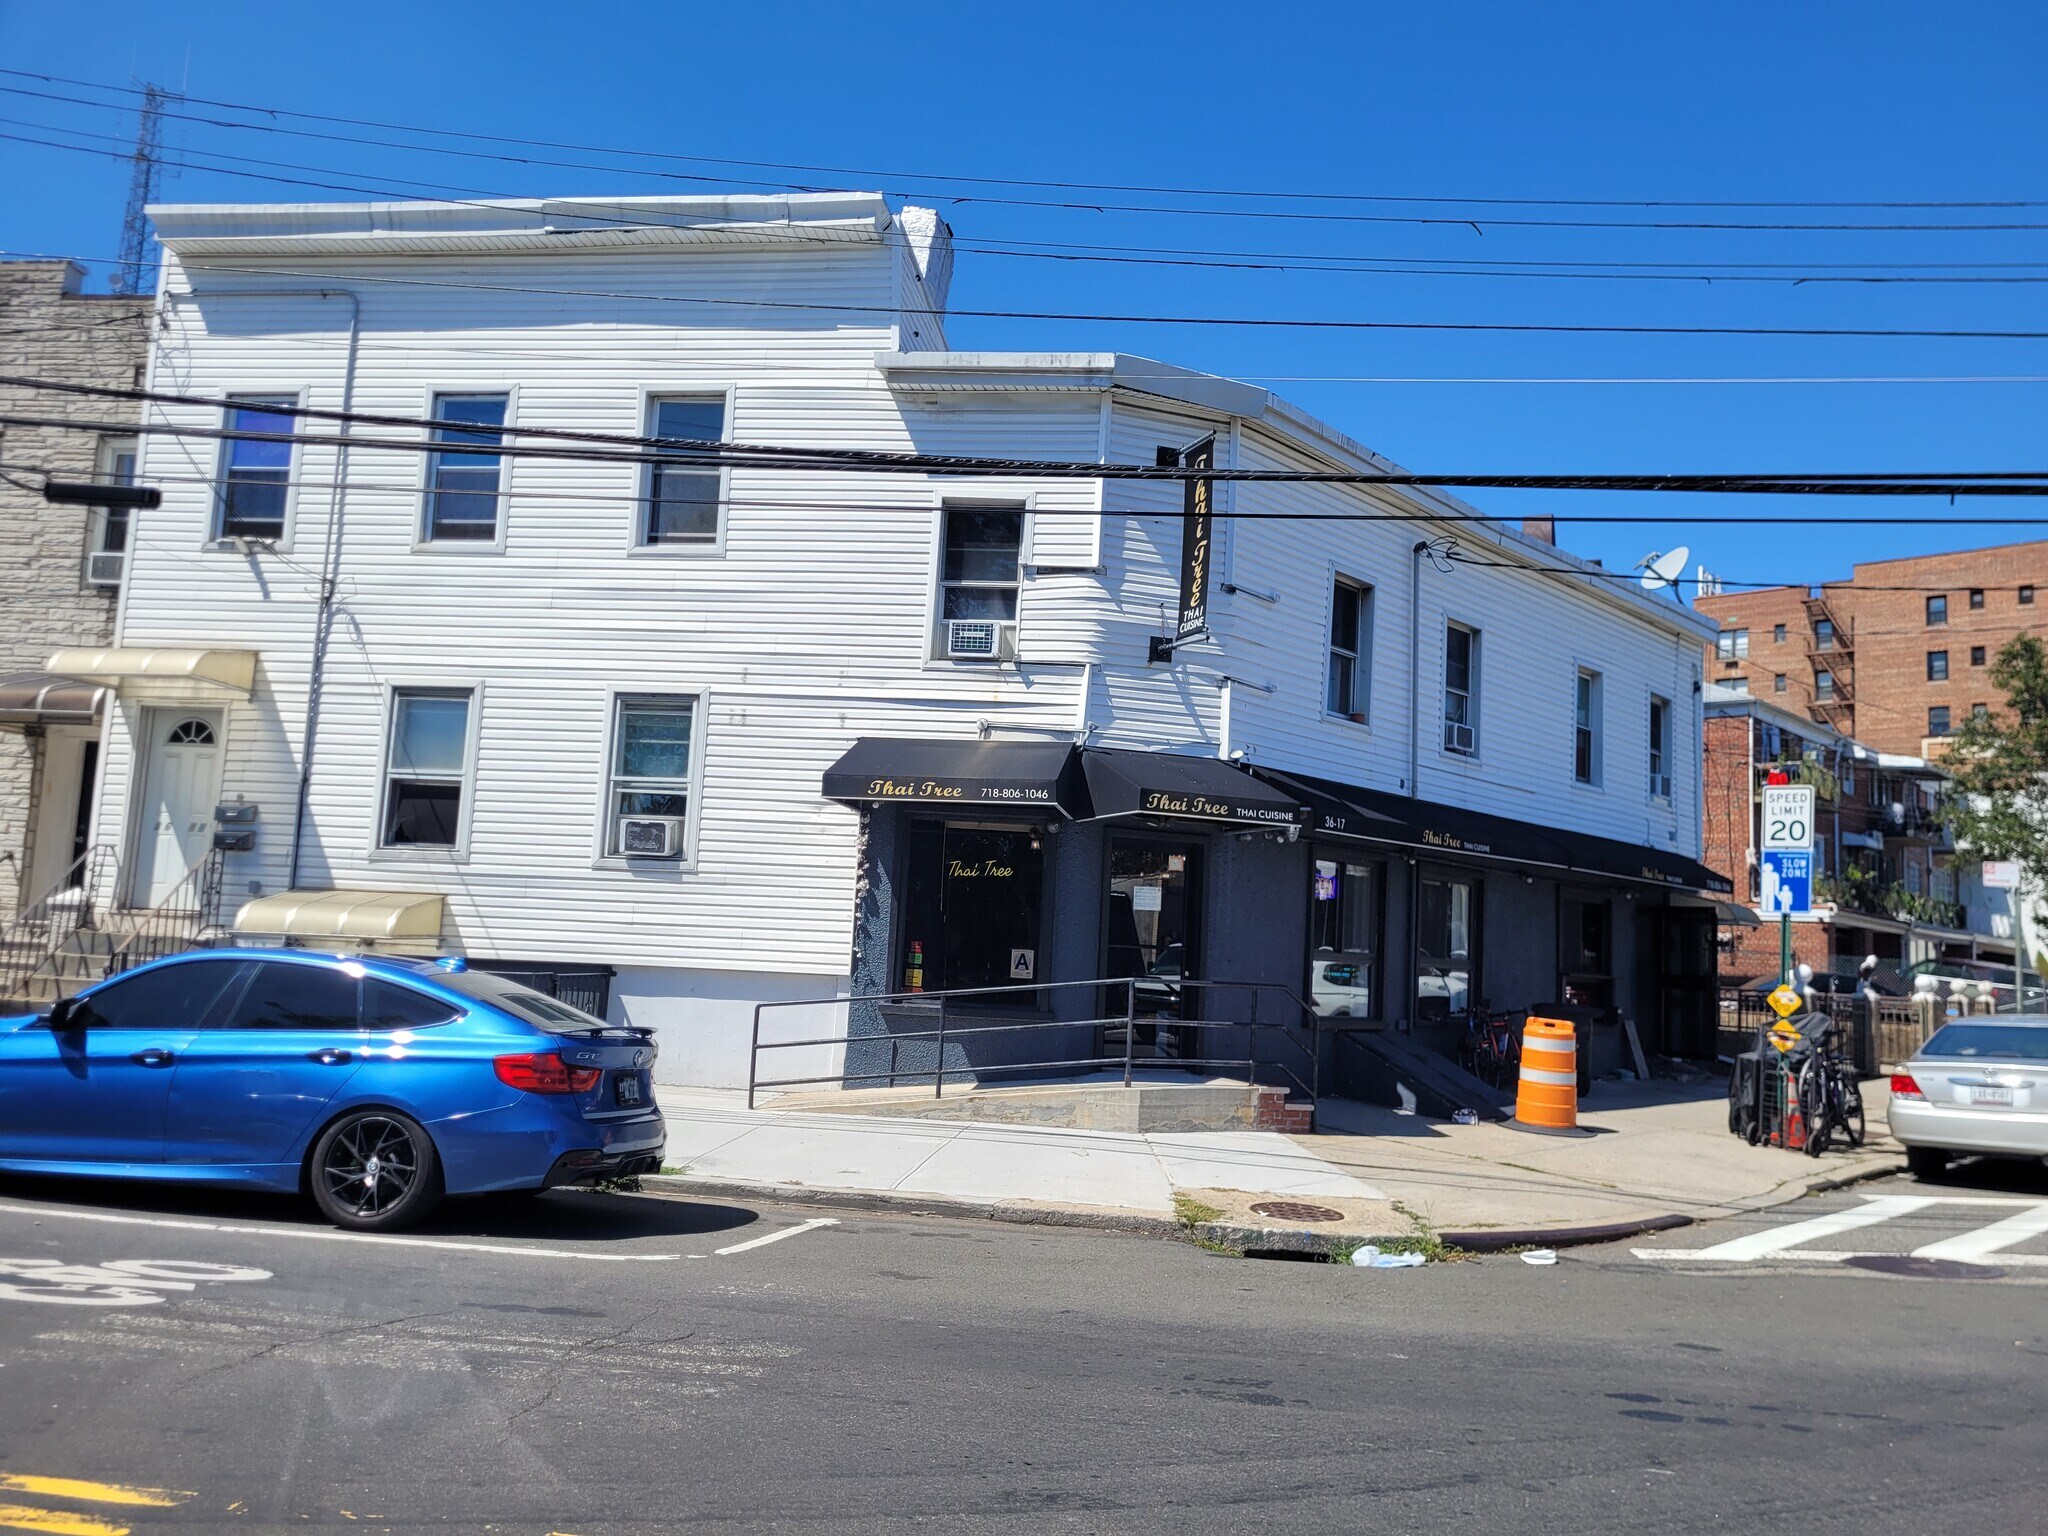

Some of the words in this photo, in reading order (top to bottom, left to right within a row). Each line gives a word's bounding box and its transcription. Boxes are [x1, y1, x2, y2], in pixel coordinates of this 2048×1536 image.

[1191, 540, 1208, 607] Tree
[1183, 605, 1204, 622] THAI
[1180, 616, 1204, 634] CUISINE
[867, 780, 915, 795] Thai
[919, 781, 962, 797] Tree
[981, 788, 1048, 799] 718-806-1046
[1146, 793, 1188, 811] Thai
[1191, 797, 1229, 815] Tree
[1236, 807, 1257, 818] THAI
[1258, 809, 1294, 821] CUISINE
[1768, 793, 1808, 804] SPEED
[1771, 806, 1804, 816] LIMIT
[1325, 815, 1345, 830] 36-17
[1770, 820, 1805, 841] 20
[1422, 829, 1442, 845] Thai
[1443, 833, 1461, 848] Tree
[949, 860, 980, 877] Thai
[984, 860, 1014, 877] Tree
[1781, 858, 1807, 868] SLOW
[1781, 868, 1807, 878] ZONE
[1014, 953, 1029, 970] A
[576, 1051, 600, 1059] GT
